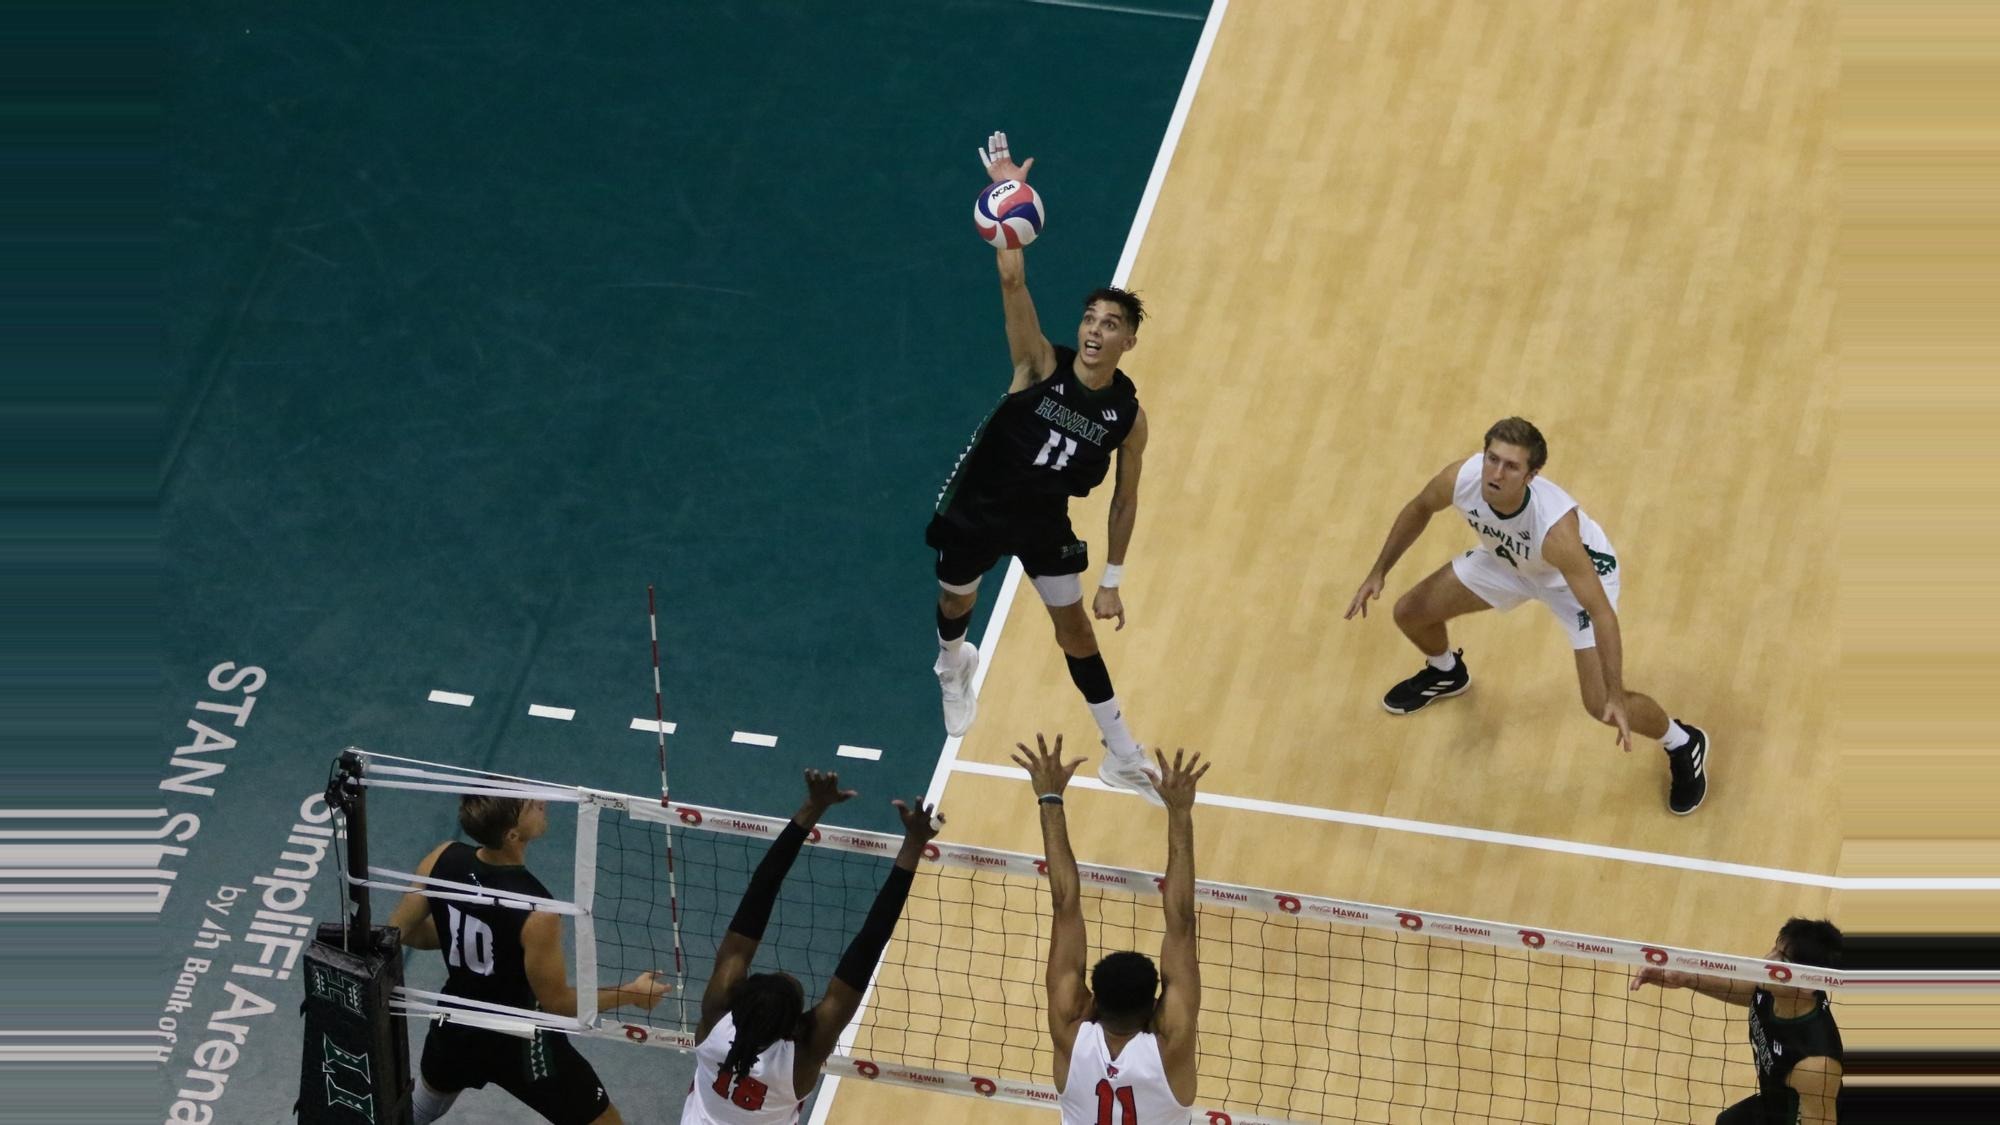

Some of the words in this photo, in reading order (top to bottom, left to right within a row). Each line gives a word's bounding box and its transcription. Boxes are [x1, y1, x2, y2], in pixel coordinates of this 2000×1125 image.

[991, 183, 1015, 199] NCAA
[1032, 428, 1078, 471] 11
[158, 661, 267, 797] STAN
[1091, 872, 1128, 885] HAWAII
[206, 885, 247, 916] by
[1211, 889, 1248, 902] HAWAII
[1332, 906, 1369, 920] HAWAII
[447, 903, 495, 977] 10
[1454, 924, 1491, 937] HAWAII
[1576, 941, 1614, 955] HAWAII
[1700, 959, 1737, 972] HAWAII
[164, 957, 212, 1013] Bank
[157, 1016, 178, 1044] of
[164, 974, 277, 1125] Arena
[1094, 1078, 1138, 1125] 11
